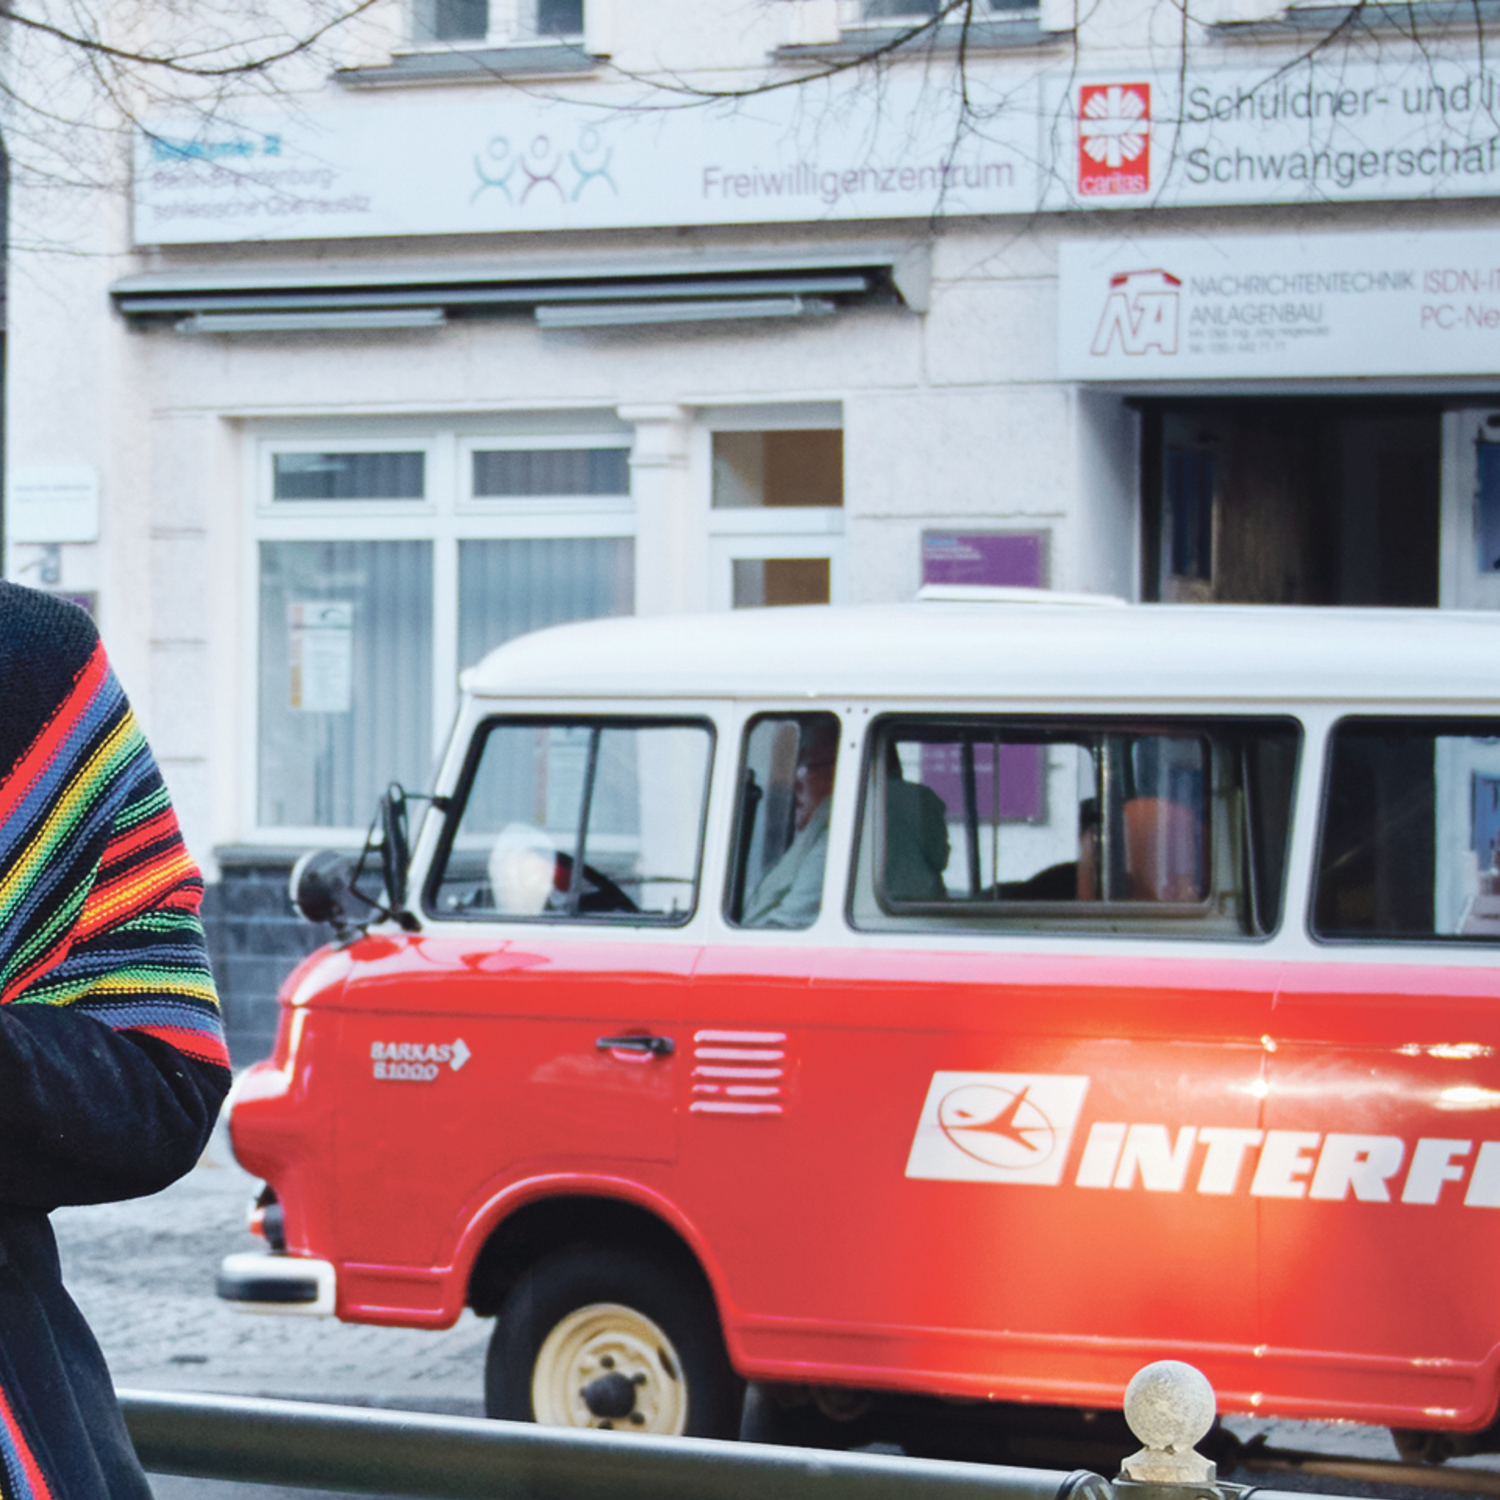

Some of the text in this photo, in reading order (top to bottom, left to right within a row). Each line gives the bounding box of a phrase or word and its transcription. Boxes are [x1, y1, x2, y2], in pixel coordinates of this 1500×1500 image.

[1188, 82, 1389, 122] Schuldner-
[1402, 75, 1471, 114] und
[1187, 136, 1500, 189] Schwangerschaf
[702, 158, 1014, 204] Freiwilligenzentrum
[1081, 171, 1146, 194] caritas
[1189, 270, 1414, 297] NACHRICHTENTECHNIK
[1188, 302, 1324, 326] ANLAGENBAU
[371, 1041, 451, 1062] BARKAS
